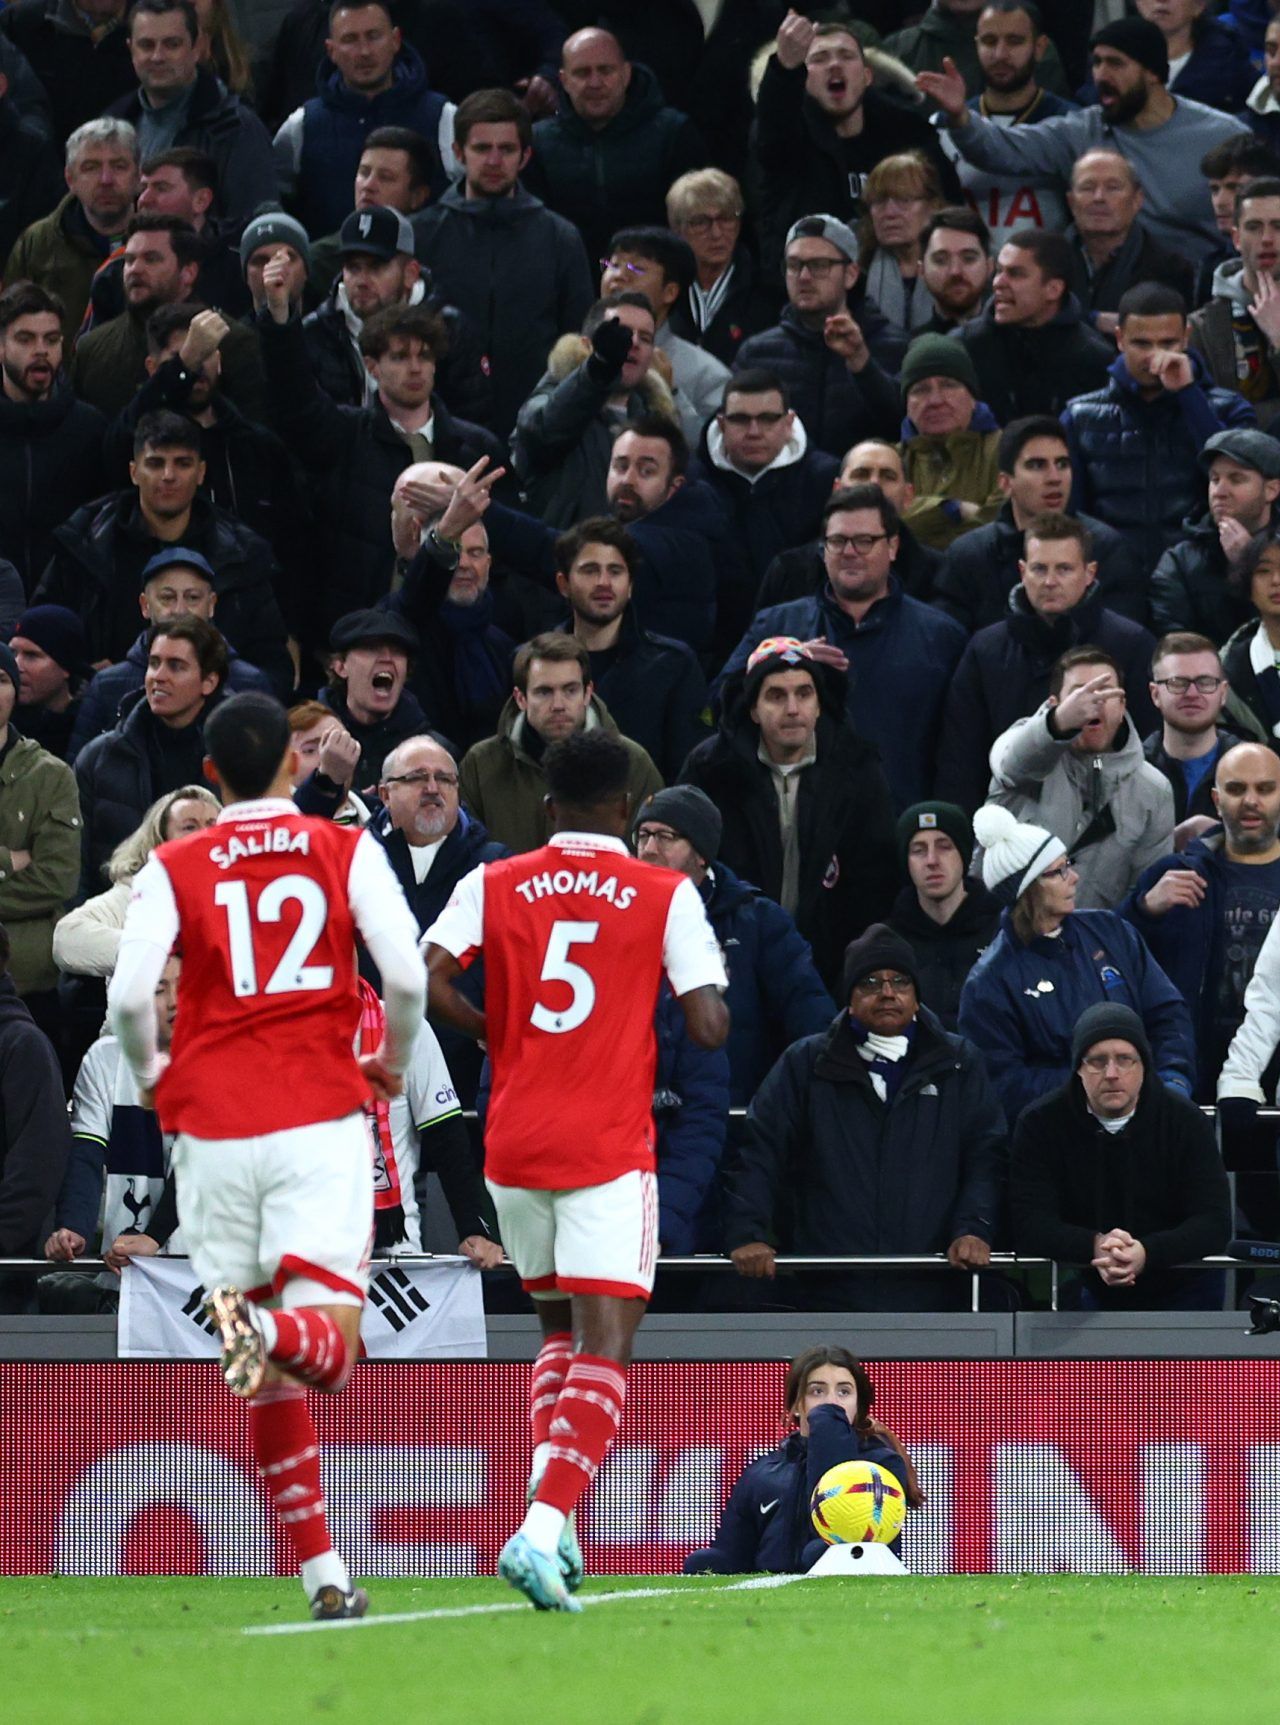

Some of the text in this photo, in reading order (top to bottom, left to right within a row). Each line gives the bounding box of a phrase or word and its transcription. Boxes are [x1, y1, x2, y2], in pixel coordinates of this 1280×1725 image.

[209, 827, 309, 870] SALIBA
[515, 869, 637, 910] THOMAS
[214, 874, 334, 997] 12
[530, 920, 600, 1034] 5
[435, 1084, 458, 1104] cin
